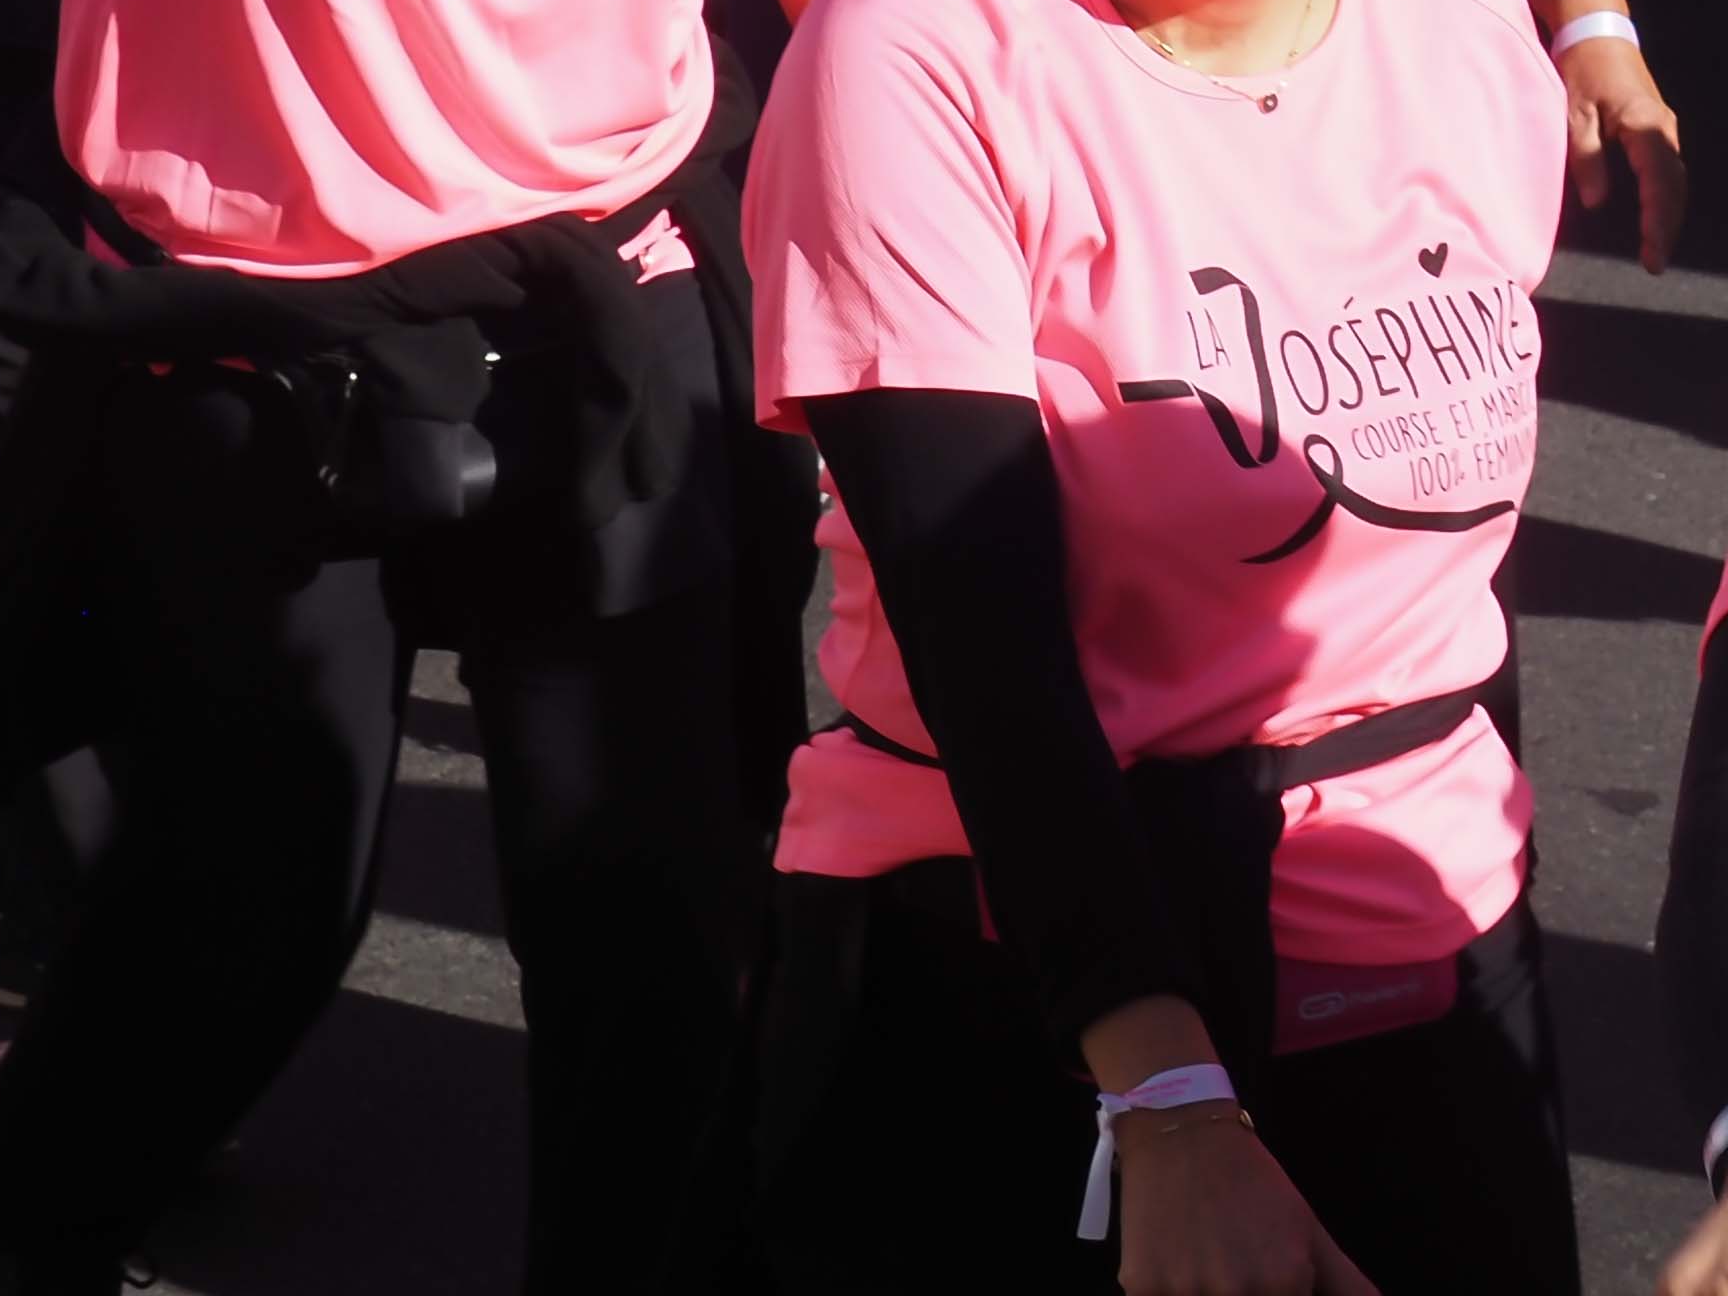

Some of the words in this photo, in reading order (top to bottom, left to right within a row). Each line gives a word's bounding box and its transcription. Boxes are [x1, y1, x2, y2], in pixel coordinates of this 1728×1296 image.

[1117, 266, 1533, 469] JOSÉPHINE
[1186, 308, 1231, 371] LA
[1350, 410, 1444, 461] COURSE
[1448, 399, 1474, 440] ET
[1409, 448, 1466, 501] 100%
